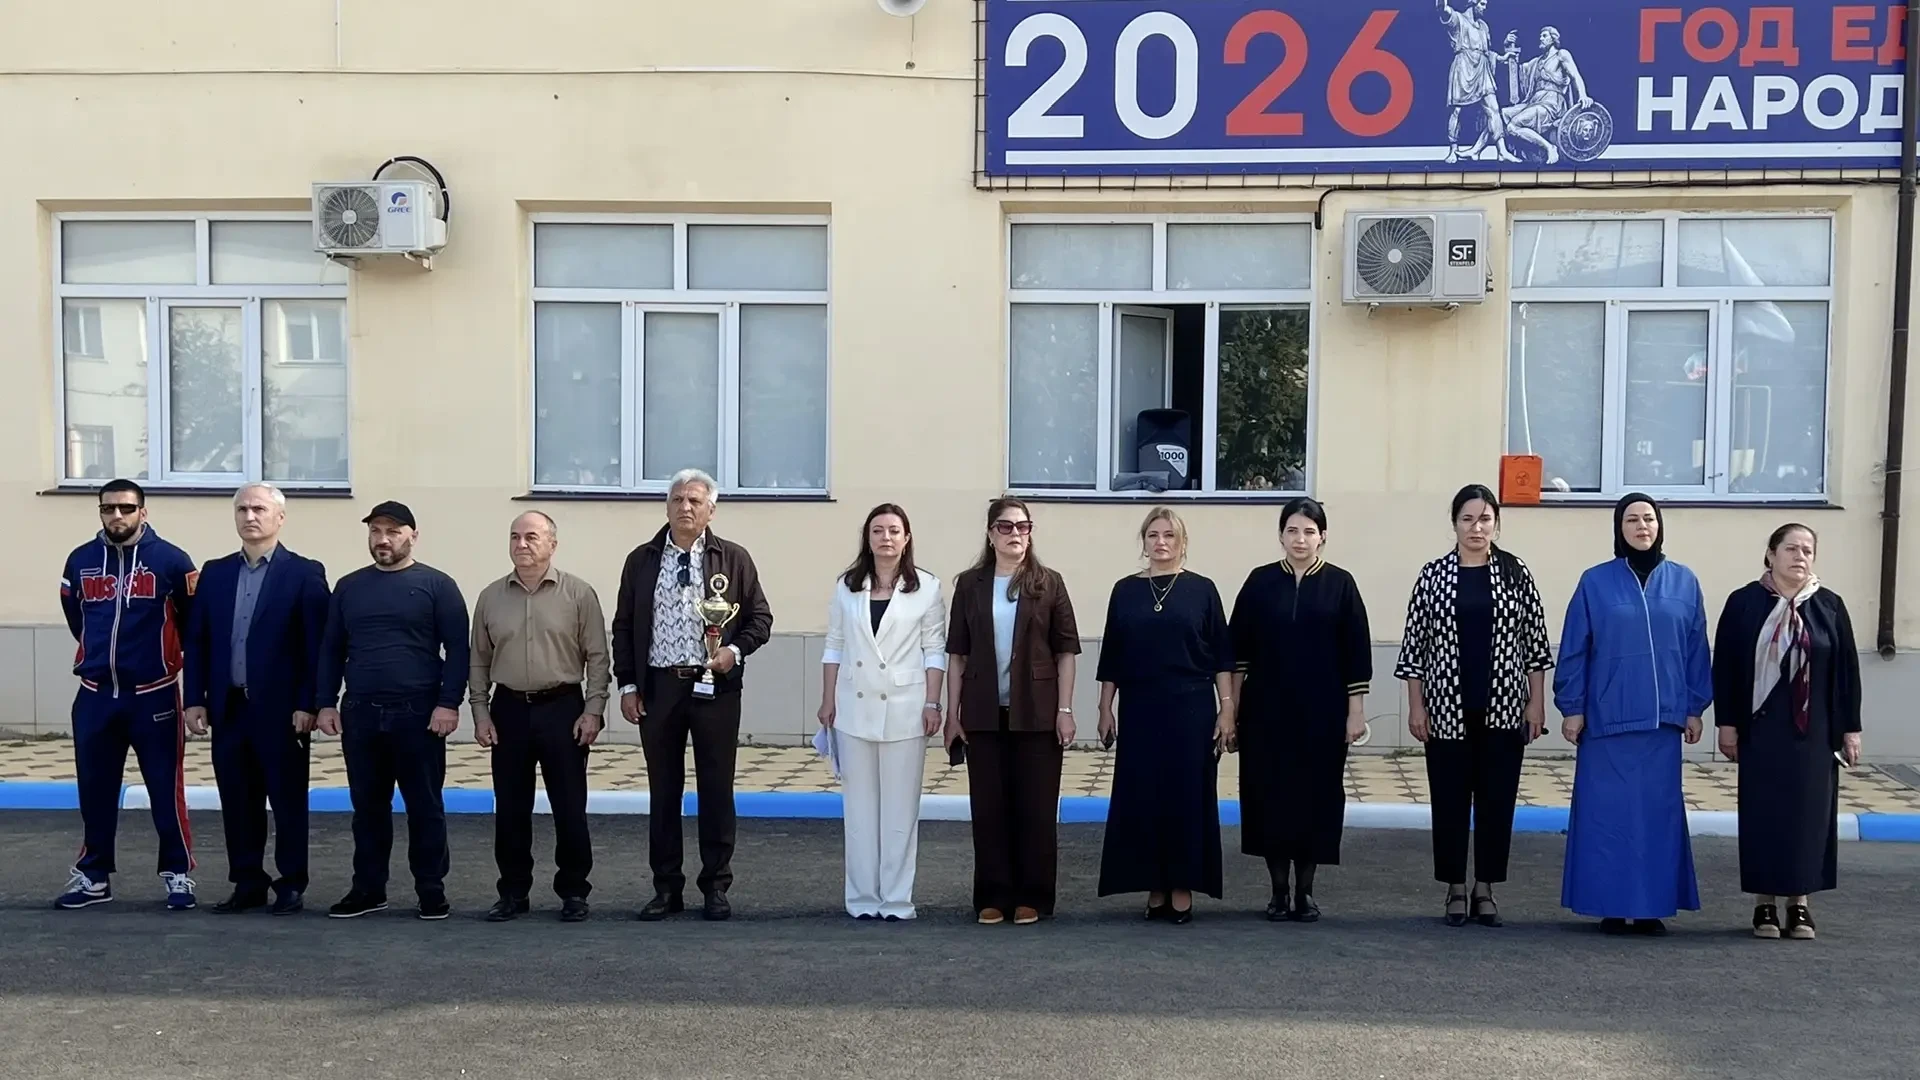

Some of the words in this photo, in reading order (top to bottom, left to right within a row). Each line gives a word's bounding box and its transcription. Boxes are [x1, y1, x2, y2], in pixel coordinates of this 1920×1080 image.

[1639, 7, 1799, 67] ГОД
[1005, 9, 1414, 140] 2026
[1637, 74, 1905, 134] НАРОД
[1160, 451, 1185, 460] 1000
